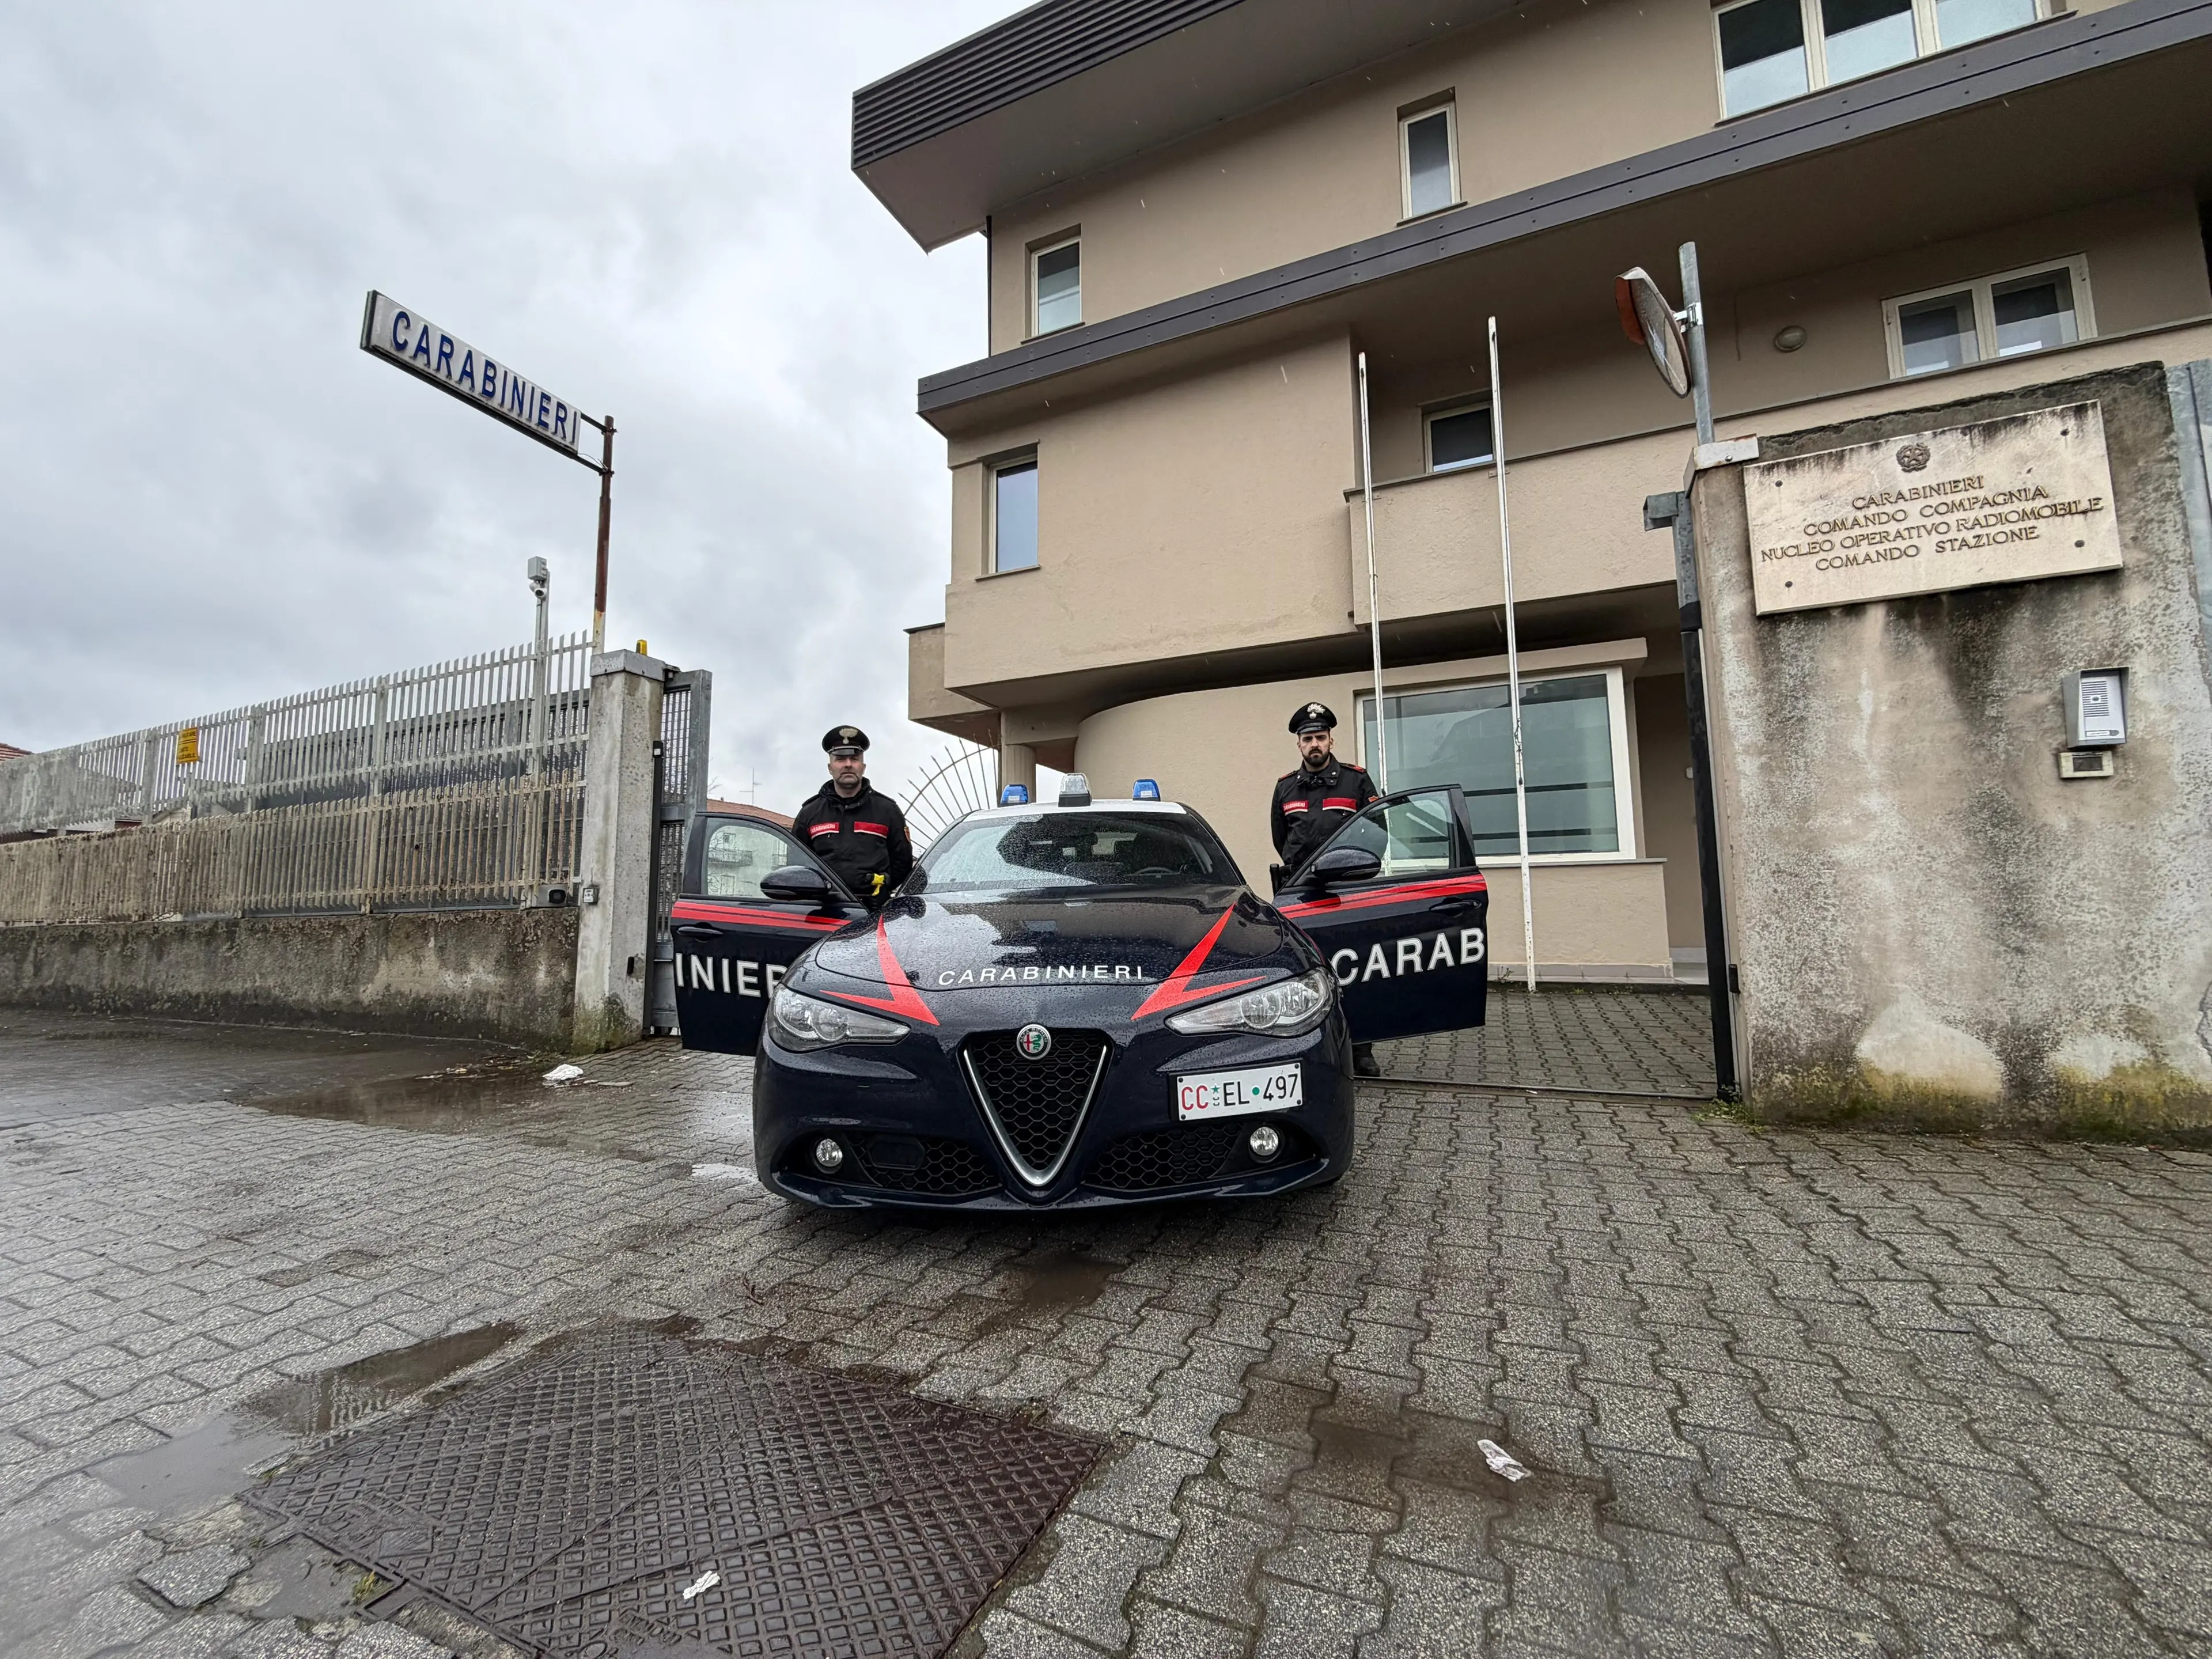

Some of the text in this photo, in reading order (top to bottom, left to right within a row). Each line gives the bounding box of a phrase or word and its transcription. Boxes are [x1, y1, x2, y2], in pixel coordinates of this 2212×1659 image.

[392, 310, 578, 445] CARABINIERI
[1804, 485, 2049, 536] COMANDO COMPAGNIA
[1852, 475, 1984, 510] CARABINIERI
[1761, 497, 2104, 562] NUCLEO OPERATIVO RADIOMOBILE
[1815, 525, 2040, 571] COMANDO STAZIONE
[938, 965, 1143, 986] CARABINIERI
[1330, 927, 1485, 987] CARAB
[1181, 1073, 1298, 1111] CC EL 497
